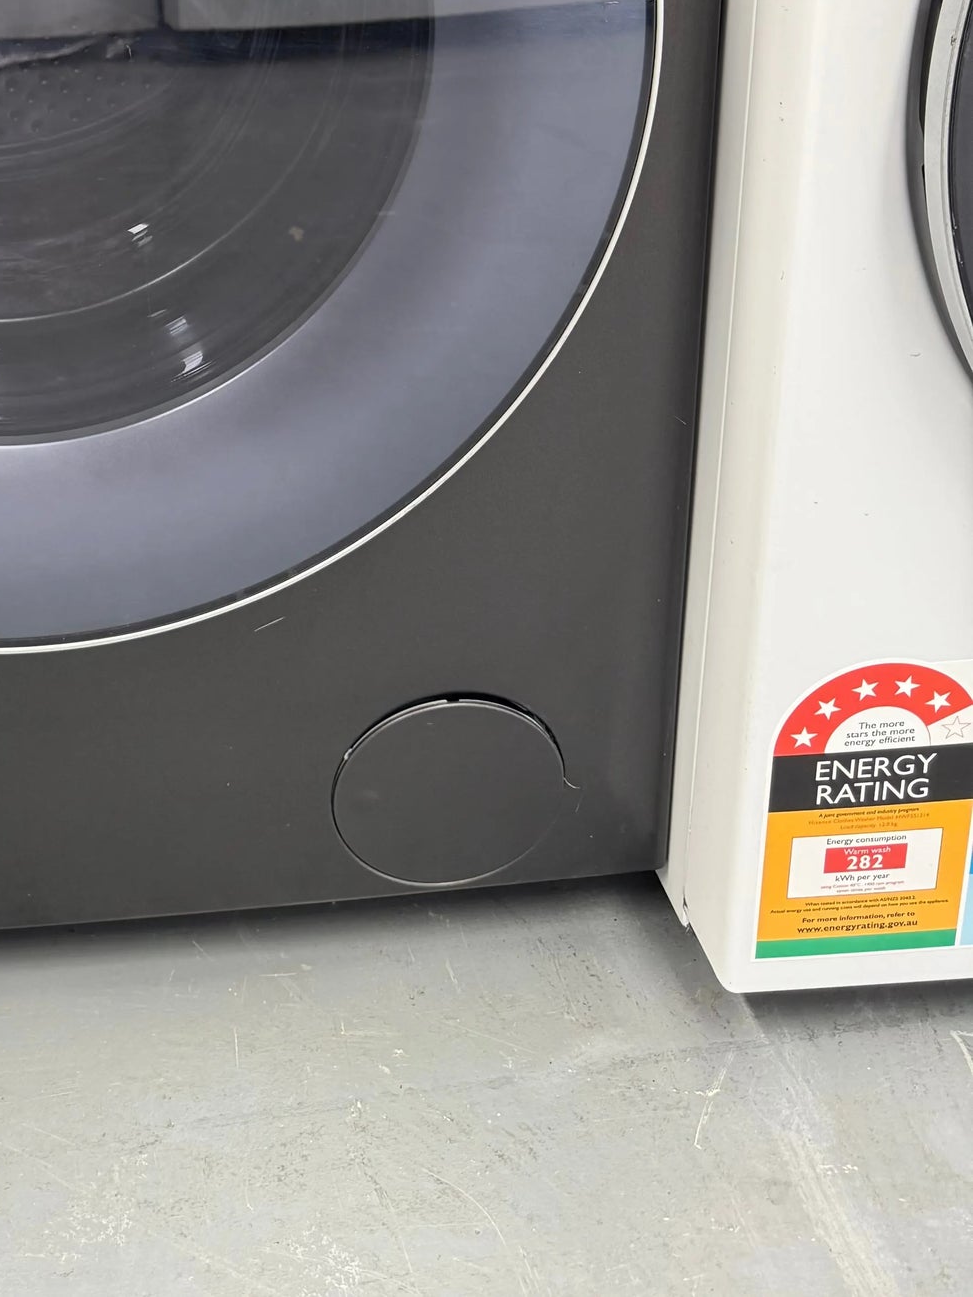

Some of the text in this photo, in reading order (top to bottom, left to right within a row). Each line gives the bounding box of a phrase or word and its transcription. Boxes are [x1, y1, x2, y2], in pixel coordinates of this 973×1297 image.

[879, 736, 915, 744] efficient
[816, 753, 937, 781] ENERGY
[816, 778, 929, 805] RATING
[856, 835, 907, 843] consumption
[847, 854, 883, 870] 282
[839, 913, 885, 922] information,
[797, 920, 918, 934] www.energyrating.gov.au
